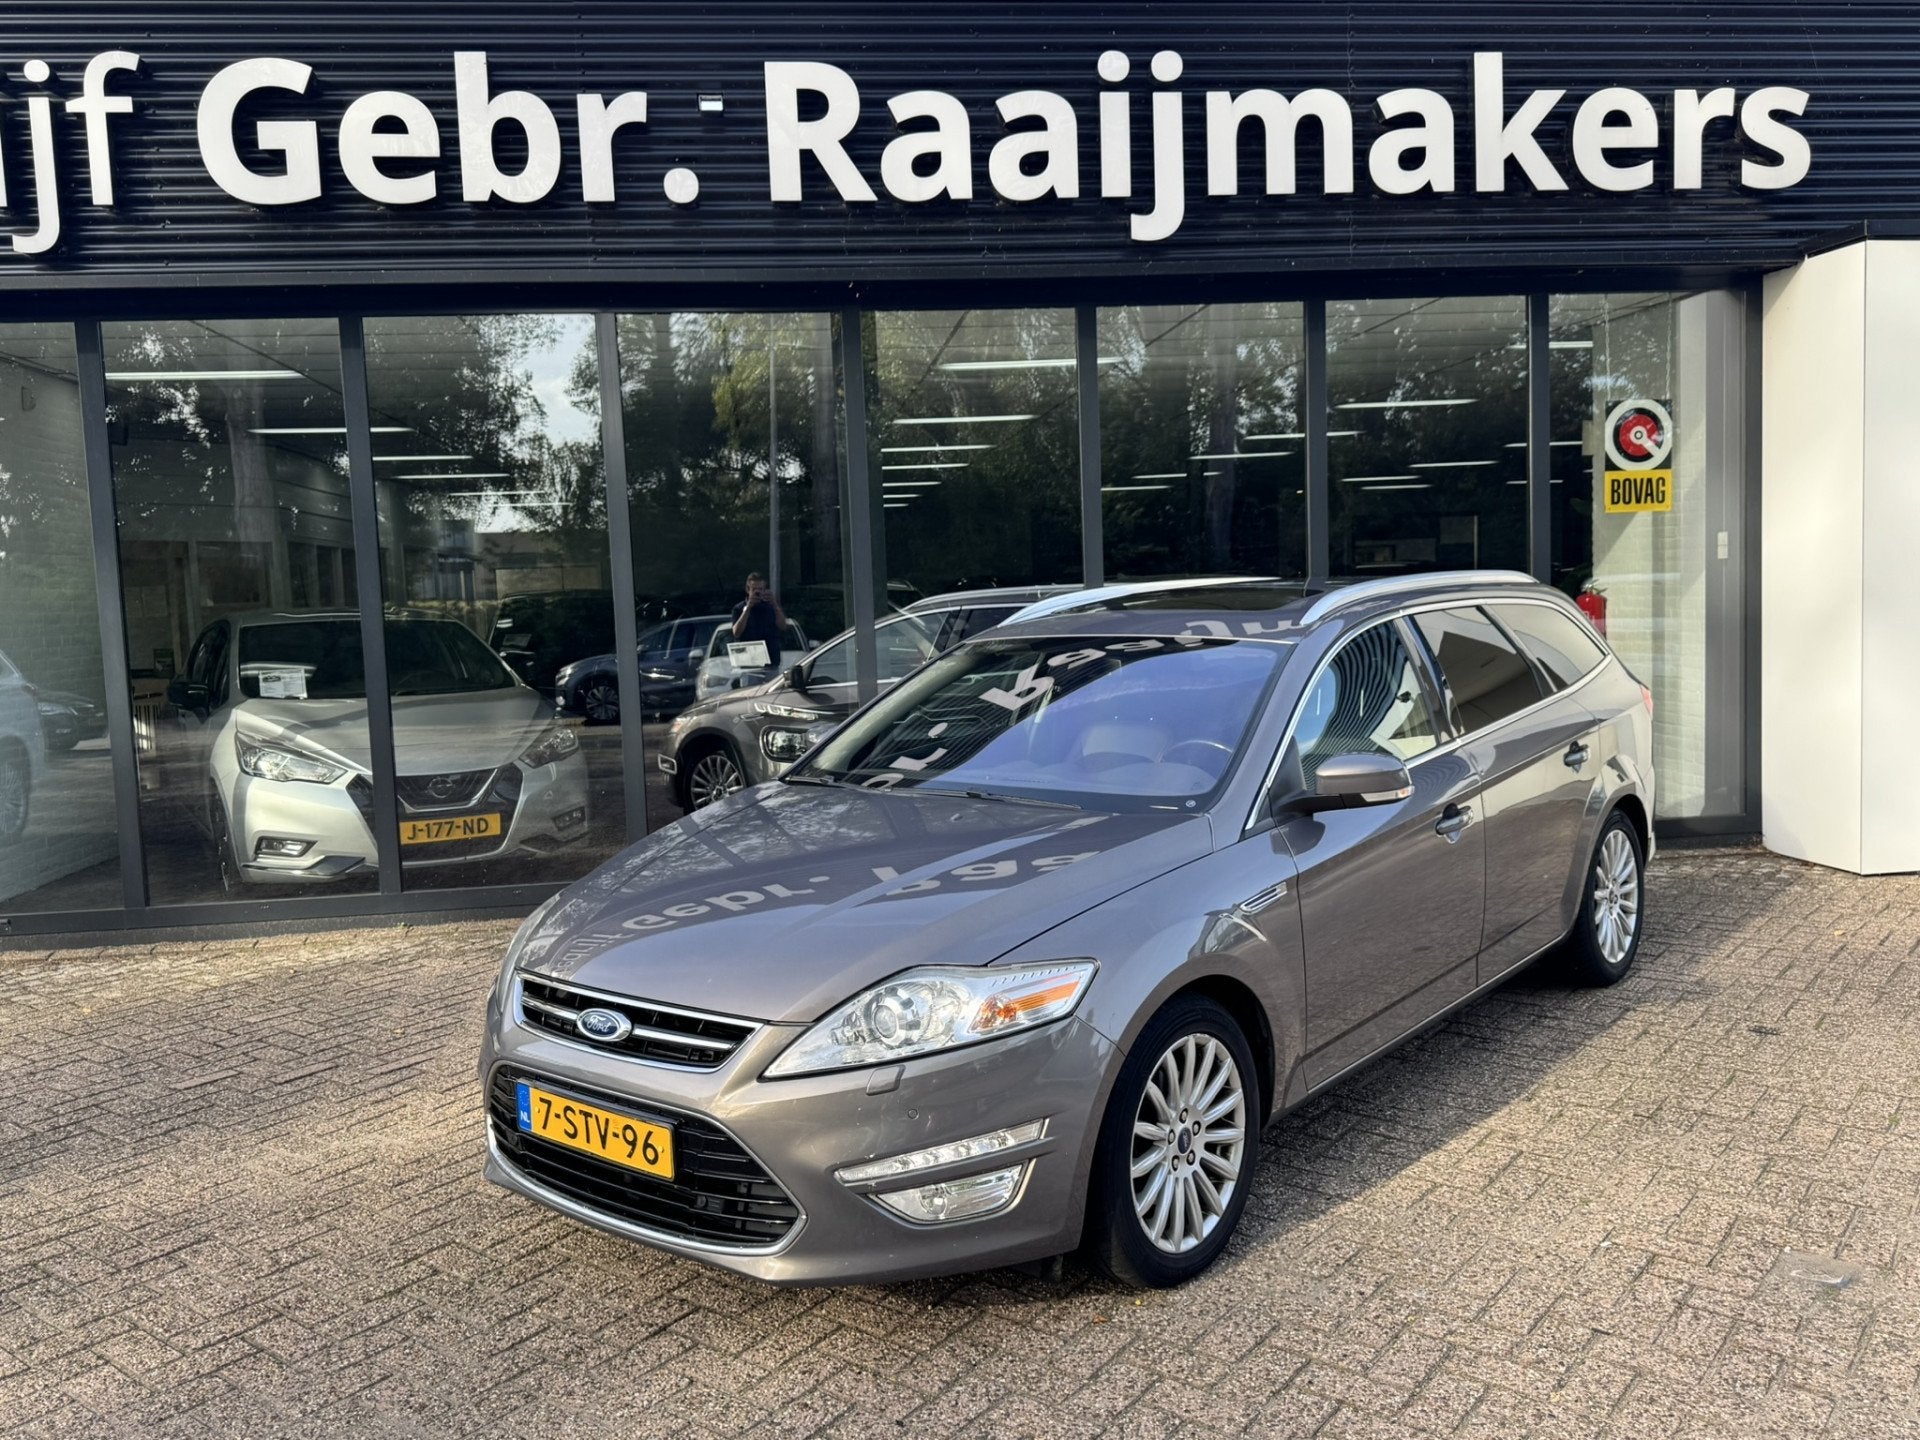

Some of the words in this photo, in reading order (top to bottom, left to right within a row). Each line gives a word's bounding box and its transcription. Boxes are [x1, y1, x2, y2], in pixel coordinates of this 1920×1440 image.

[0, 51, 140, 254] jf
[197, 52, 699, 205] Gebr.
[764, 51, 1811, 241] Raaijmakers
[1610, 477, 1666, 505] BOVAG
[407, 818, 489, 840] J-177-ND
[586, 1014, 612, 1033] Ford
[520, 1110, 531, 1123] NL
[539, 1097, 659, 1166] 7-STV-96
